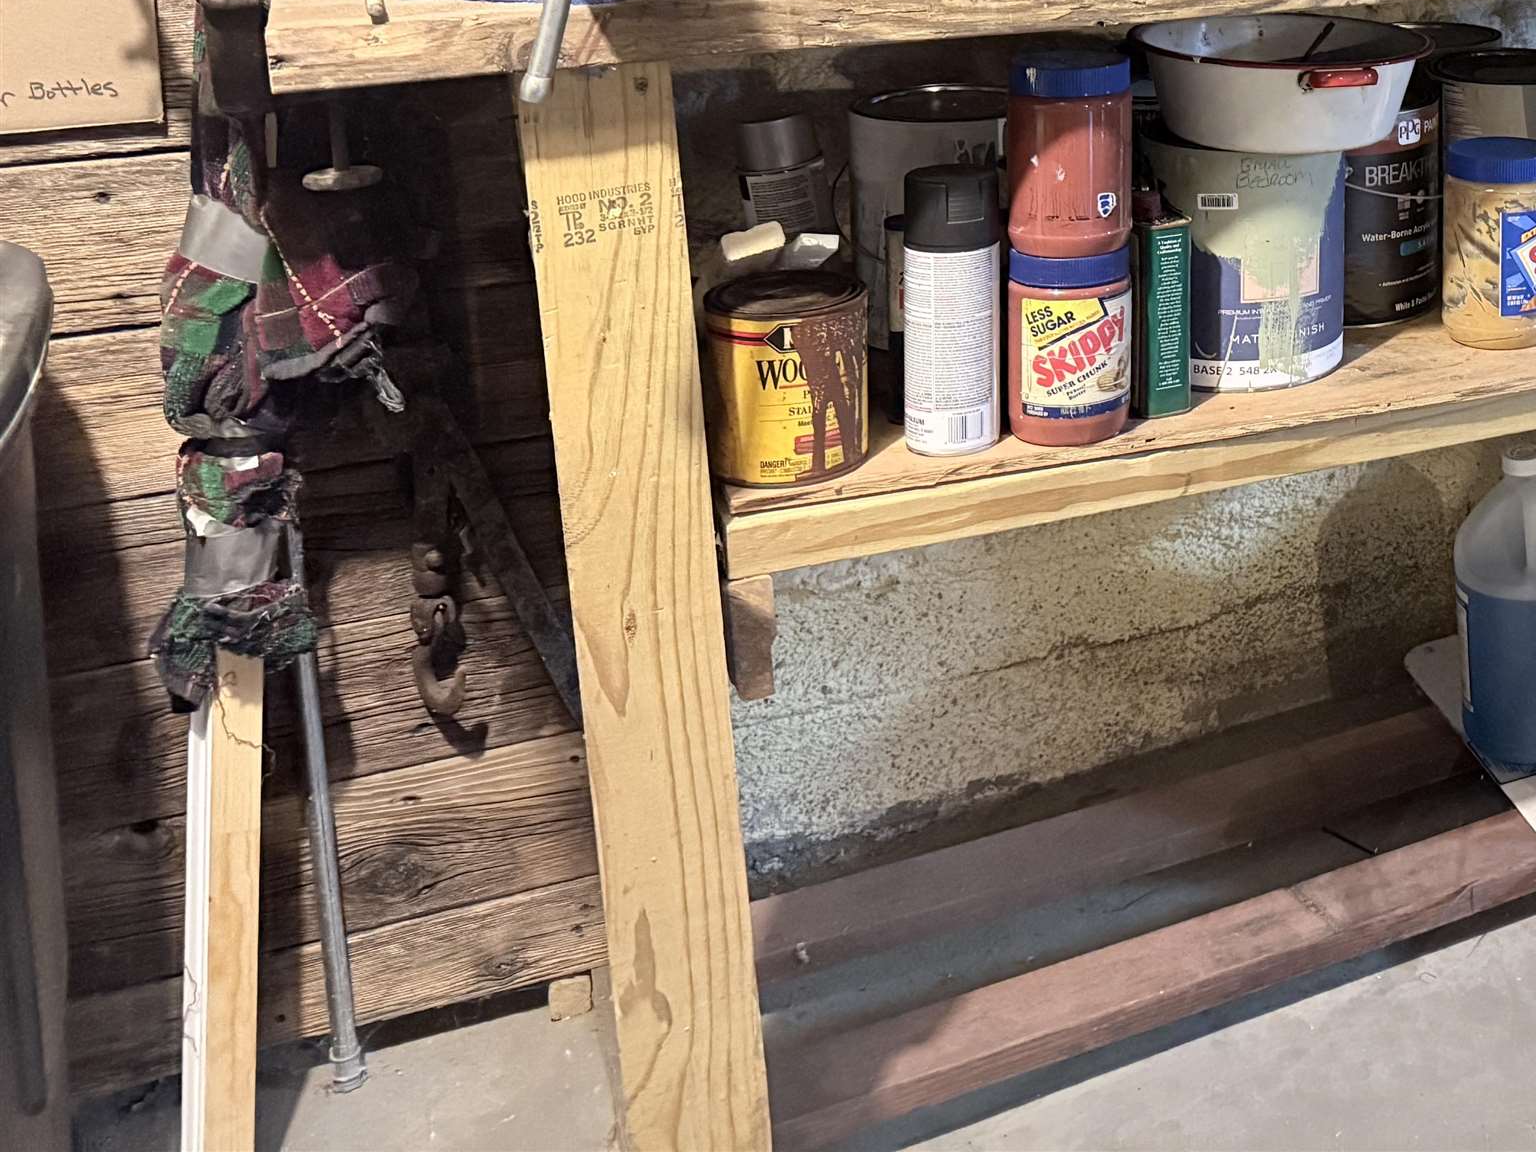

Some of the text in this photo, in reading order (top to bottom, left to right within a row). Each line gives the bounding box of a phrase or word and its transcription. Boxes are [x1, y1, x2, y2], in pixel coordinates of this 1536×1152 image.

[28, 78, 119, 100] Bottles
[1399, 120, 1421, 141] PPG
[556, 182, 651, 206] HOOD INDUSTRIES
[639, 192, 653, 206] 2
[563, 228, 597, 248] 232
[1362, 224, 1413, 243] Water-Borne
[1026, 305, 1054, 326] LESS
[1218, 308, 1251, 316] PREMIUM
[1030, 310, 1077, 337] SUGAR
[1230, 321, 1326, 345] MAT NISH
[1032, 305, 1125, 388] SKIPPY
[1046, 359, 1109, 397] SUPER CHUNK
[1193, 364, 1222, 376] BASE
[1239, 366, 1260, 376] 548
[788, 406, 813, 417] STAI
